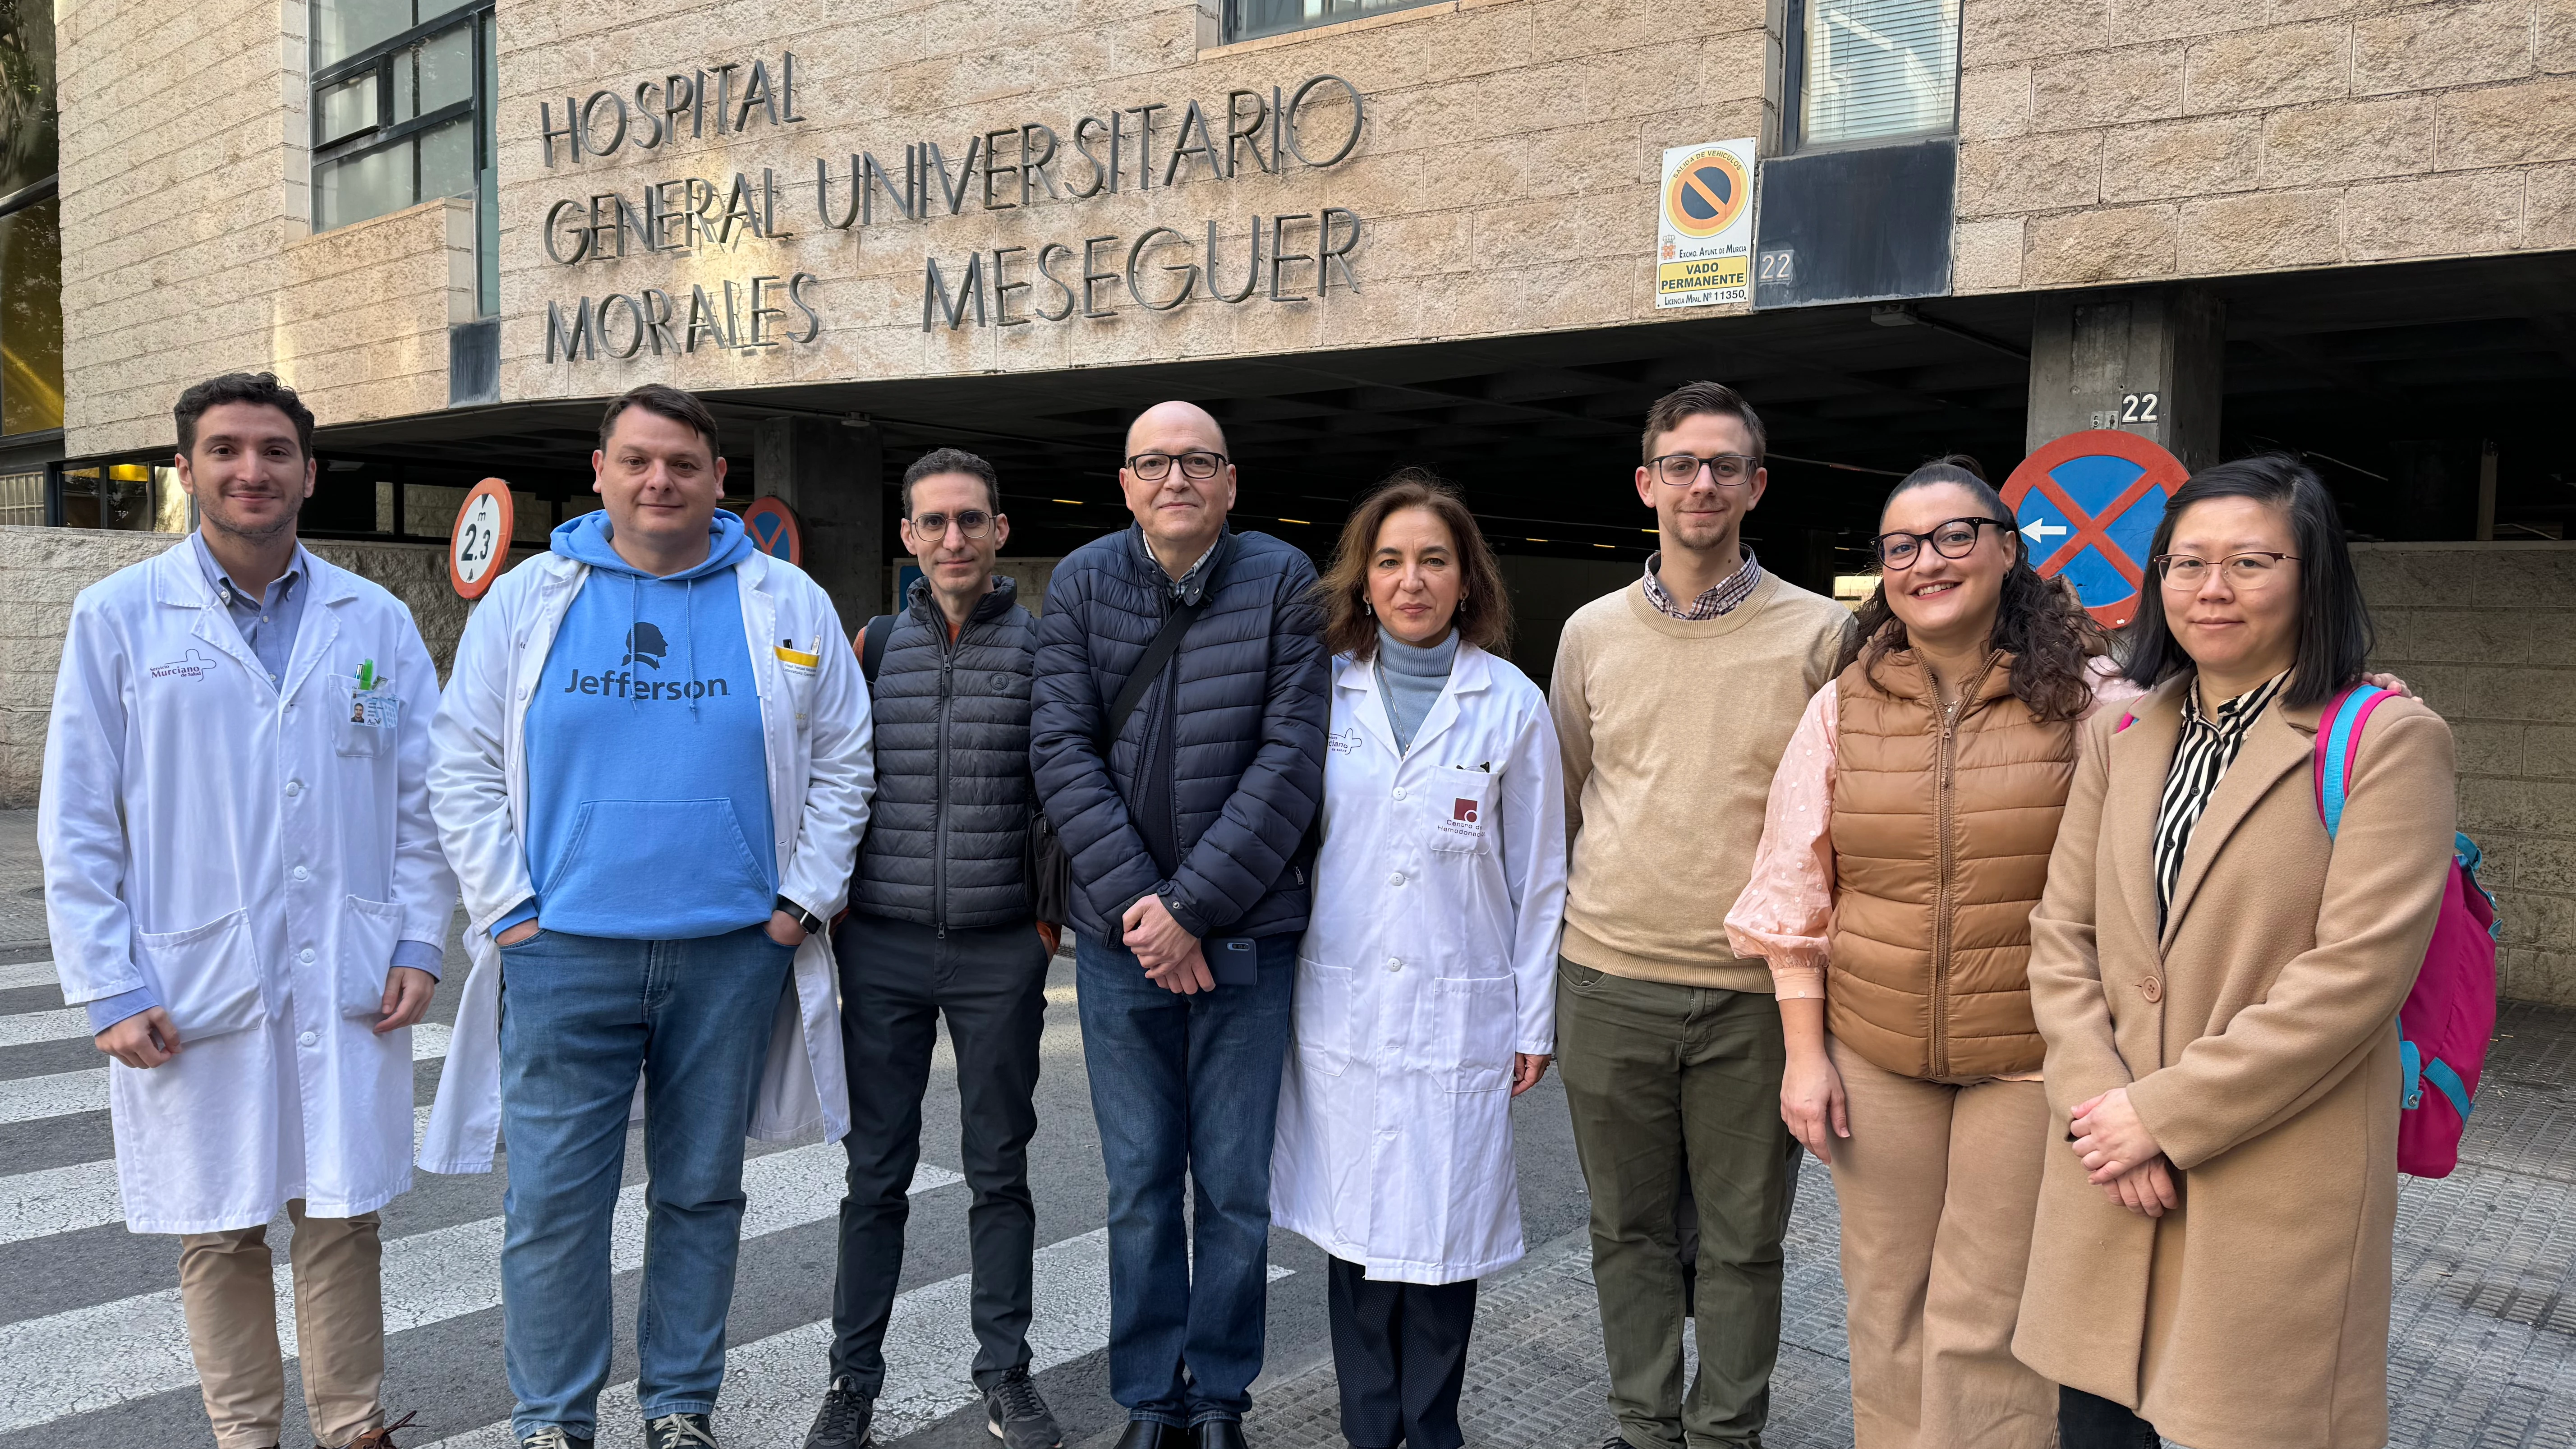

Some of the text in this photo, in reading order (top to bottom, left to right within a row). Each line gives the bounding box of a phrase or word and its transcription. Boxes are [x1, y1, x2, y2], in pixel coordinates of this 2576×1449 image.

[540, 50, 806, 168] HOSPITAL
[544, 74, 1363, 265] GENERAL UNIVERSITARIO
[1673, 157, 1695, 178] SALIDA
[1707, 150, 1742, 170] VEHICULOS
[1686, 262, 1719, 275] VADO
[1761, 253, 1790, 280] 22
[545, 207, 1361, 363] MORALES MESEGUER
[1661, 273, 1744, 290] PERMANENTE
[1714, 290, 1744, 300] 11350
[2122, 393, 2157, 423] 22
[477, 512, 486, 521] m
[460, 523, 491, 561] 2.3
[152, 666, 199, 678] Murciano
[565, 669, 730, 700] Jefferson
[1329, 740, 1348, 749] ciano
[1447, 819, 1472, 828] Centro
